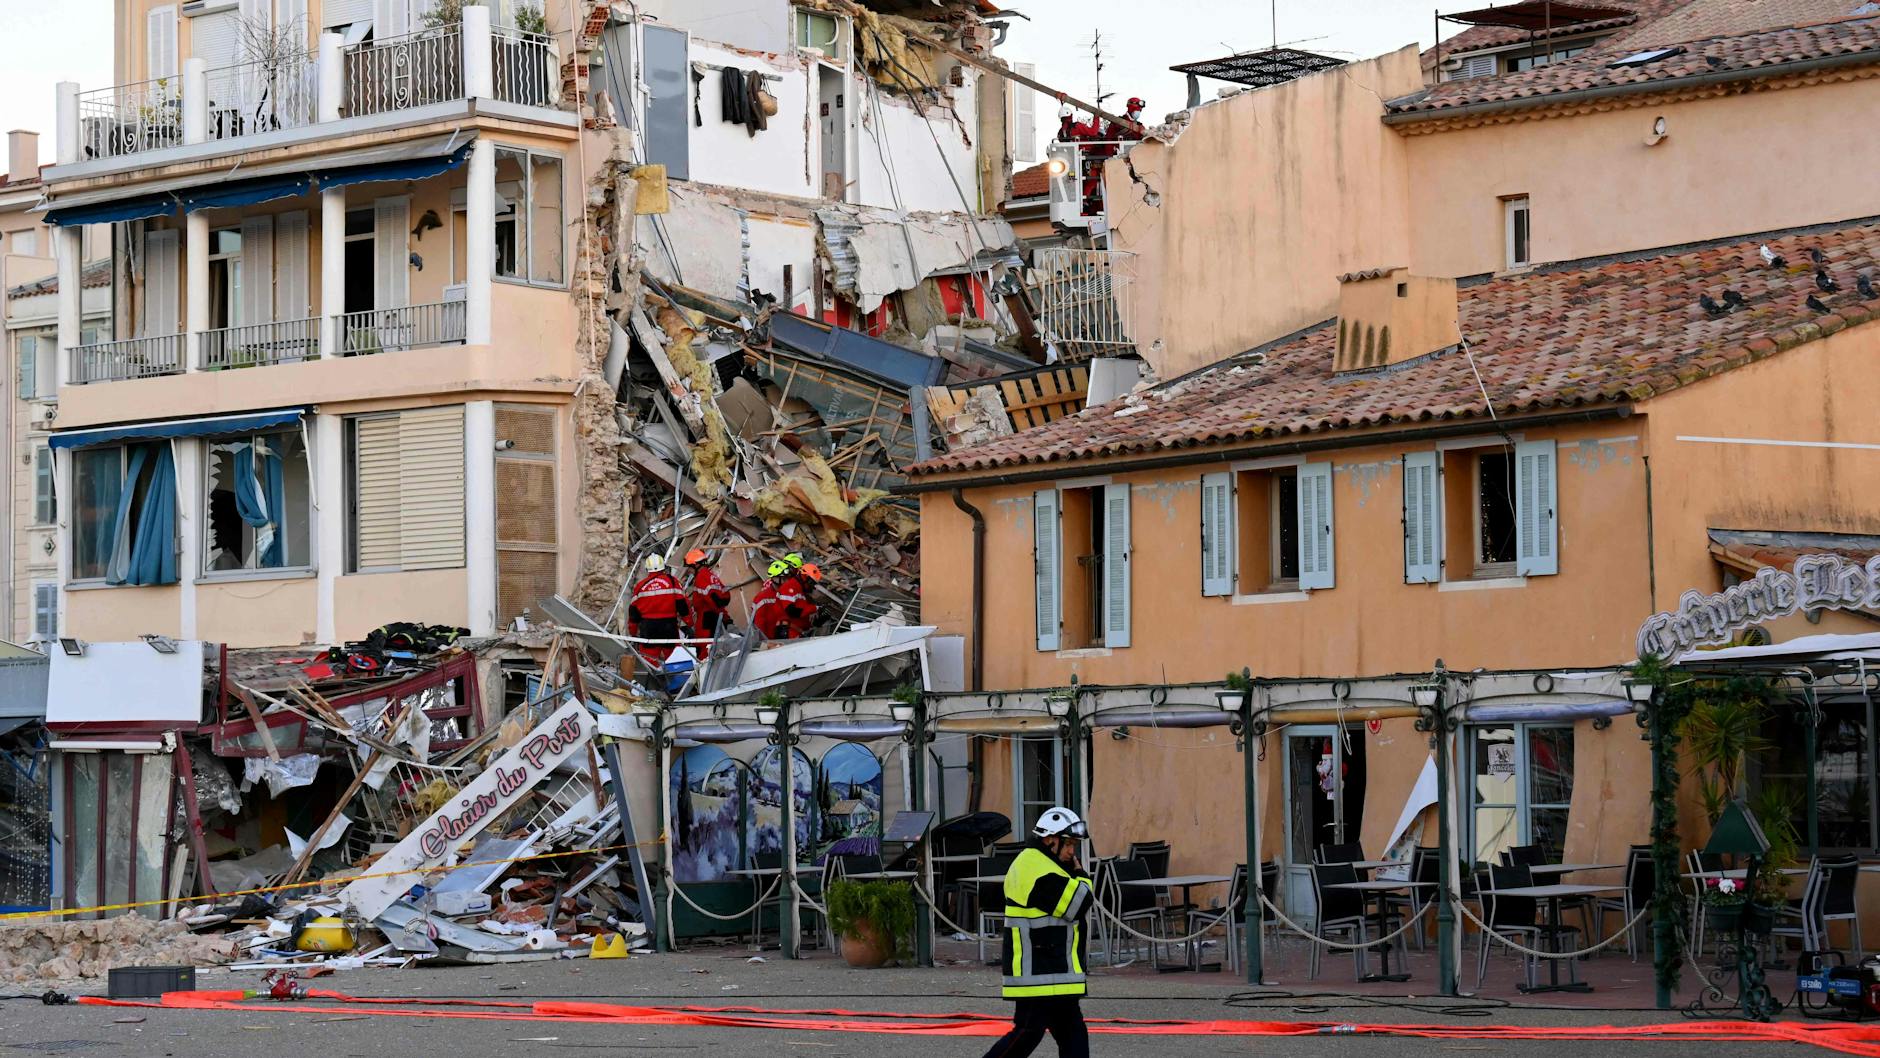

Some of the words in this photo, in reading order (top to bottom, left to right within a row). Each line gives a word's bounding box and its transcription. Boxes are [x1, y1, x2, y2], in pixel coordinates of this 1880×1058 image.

[1642, 567, 1796, 661] Crêperie
[1801, 562, 1866, 607] Le
[422, 794, 498, 858] Glacier
[498, 767, 527, 797] du
[520, 712, 581, 769] Port
